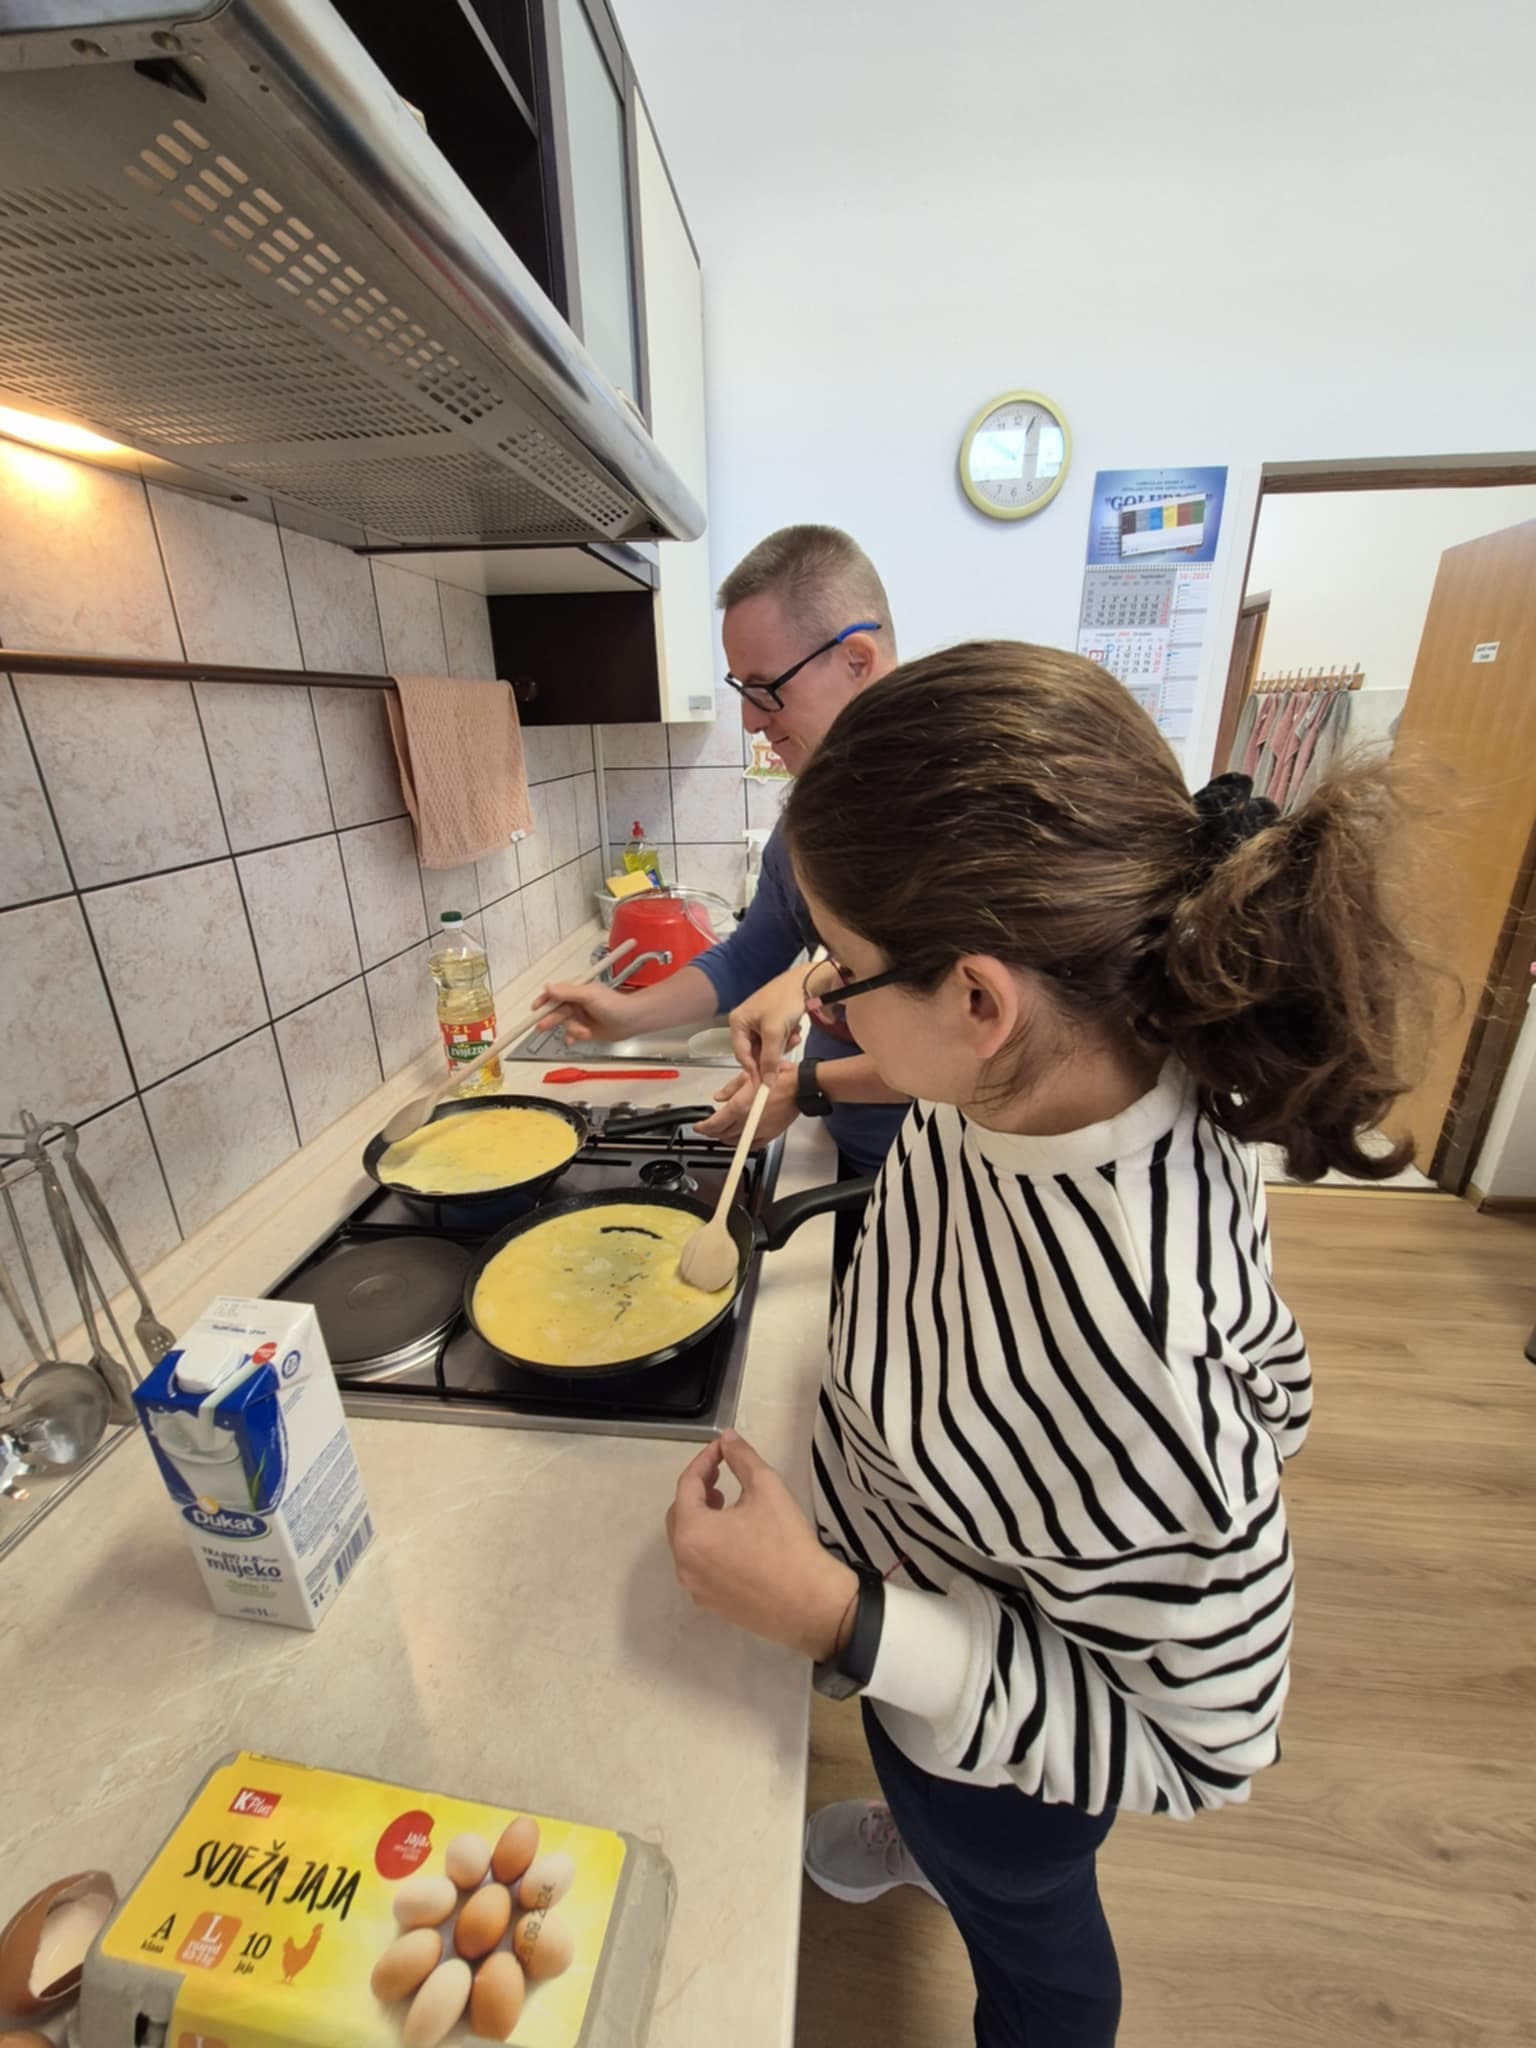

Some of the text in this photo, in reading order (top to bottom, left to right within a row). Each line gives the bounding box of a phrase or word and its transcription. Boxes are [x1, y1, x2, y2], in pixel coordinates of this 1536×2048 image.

[192, 1509, 257, 1532] Dukat
[206, 1557, 281, 1578] mlijeko
[183, 1839, 361, 1921] SVJEŽA JAJA
[151, 1912, 272, 1960] A L 10
